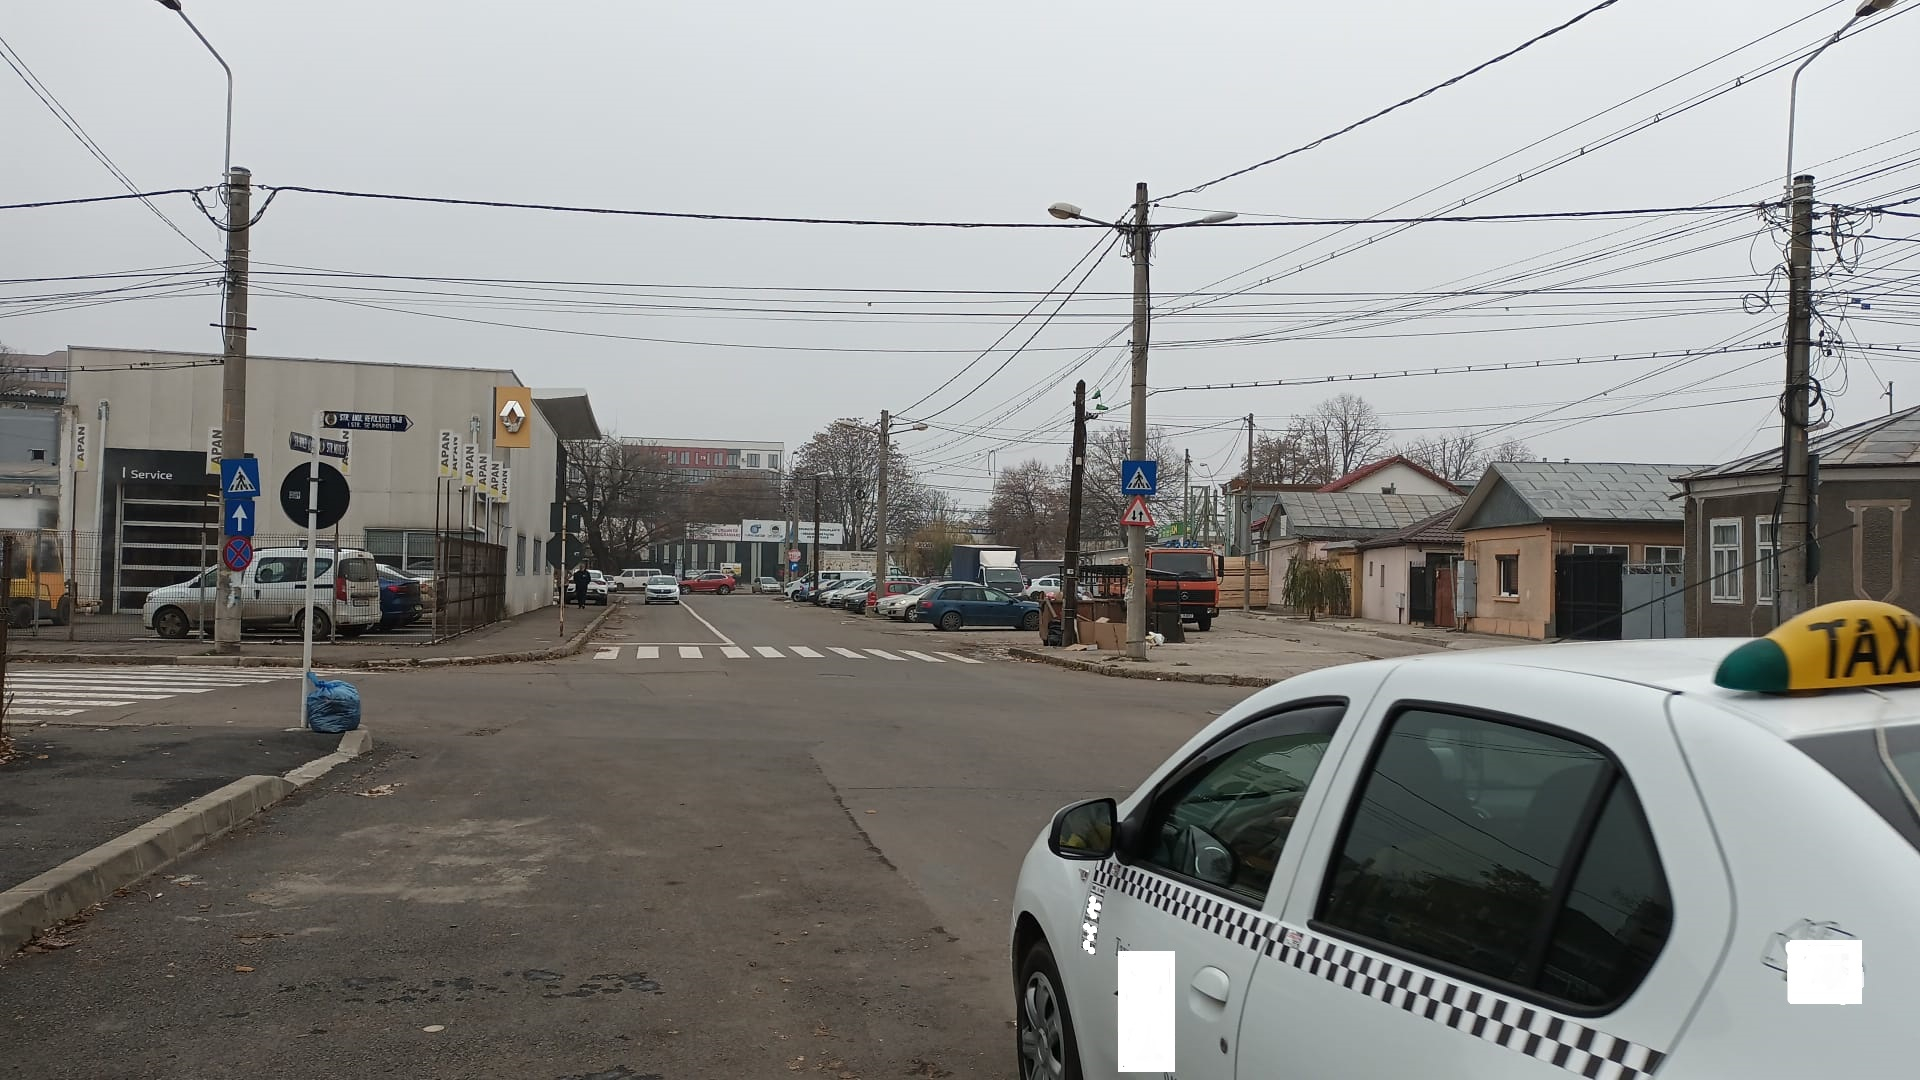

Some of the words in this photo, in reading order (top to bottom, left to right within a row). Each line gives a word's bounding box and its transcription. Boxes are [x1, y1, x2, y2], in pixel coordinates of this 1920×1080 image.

[77, 426, 86, 462] APAN
[211, 429, 223, 465] APAN
[441, 432, 450, 468] APAN
[130, 469, 173, 480] Service
[465, 446, 474, 478] APAN
[478, 456, 487, 486] APAN
[490, 463, 499, 491] APAN
